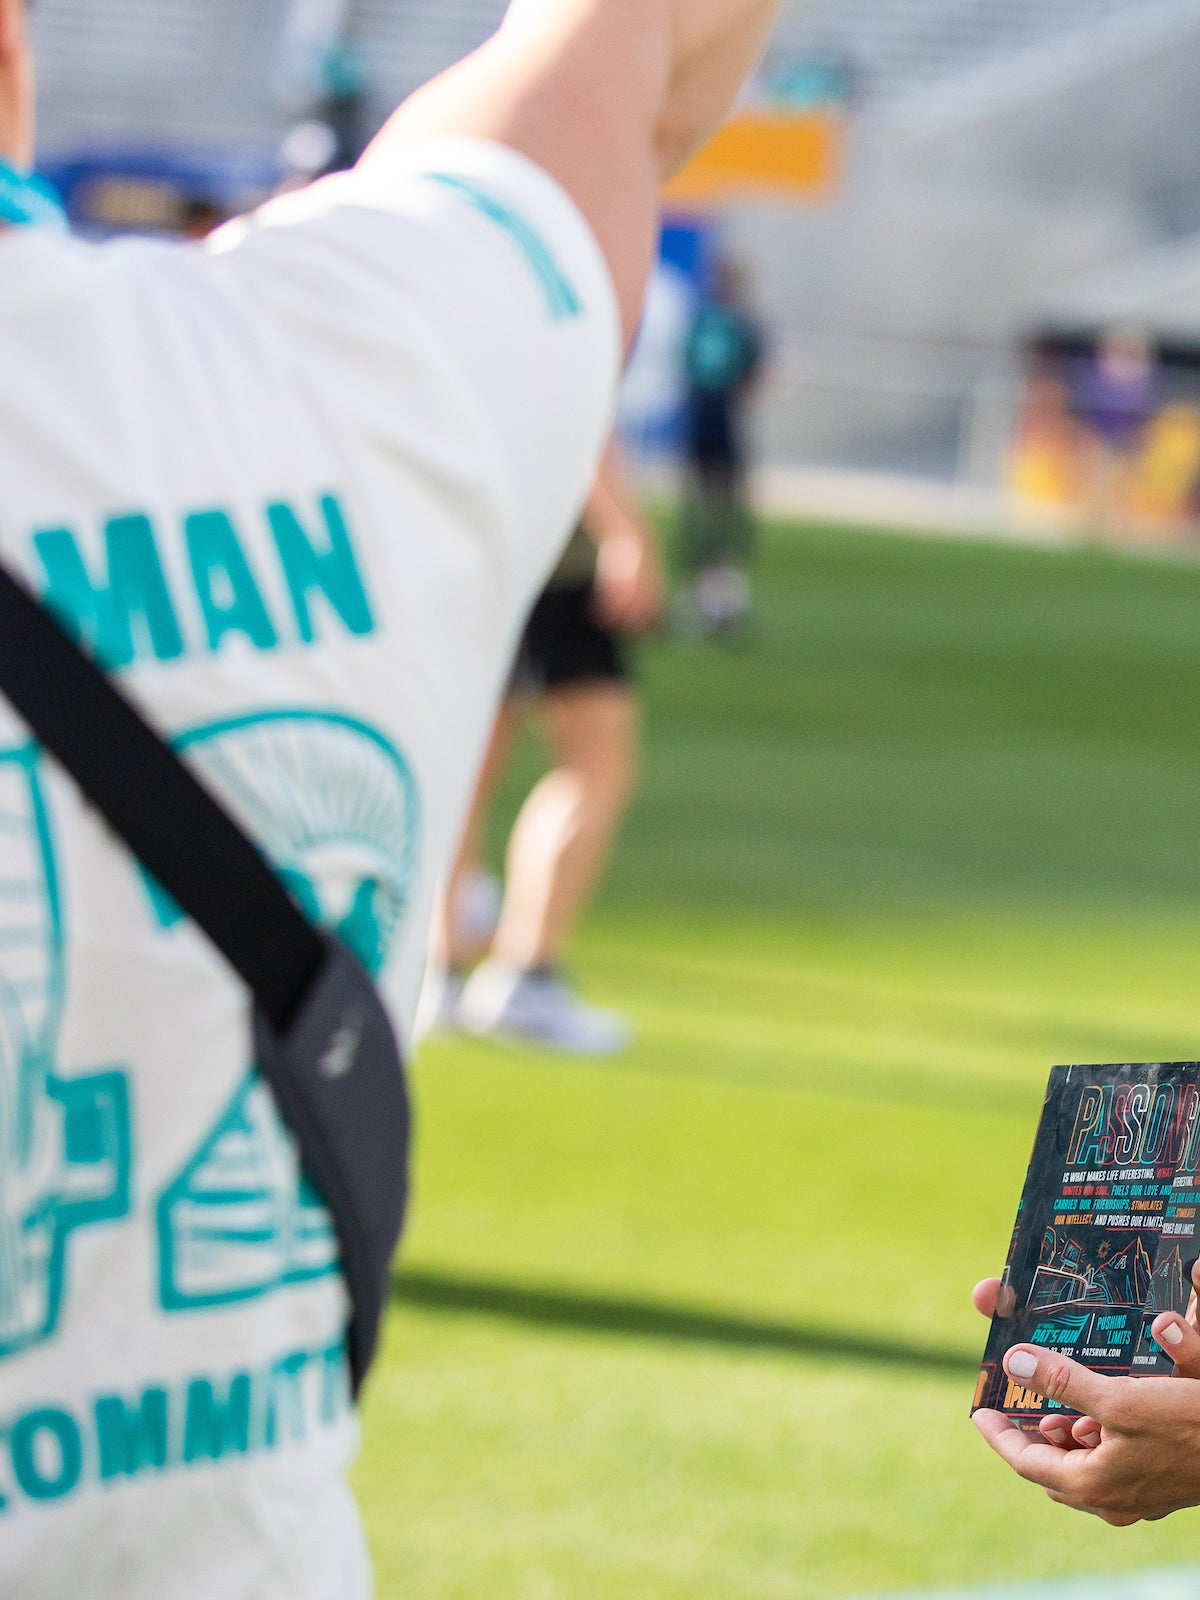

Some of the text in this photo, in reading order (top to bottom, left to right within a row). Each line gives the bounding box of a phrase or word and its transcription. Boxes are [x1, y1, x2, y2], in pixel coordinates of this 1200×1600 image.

[1065, 1083, 1196, 1166] PASSION
[1062, 1172, 1070, 1183] IS
[1070, 1171, 1087, 1182] WHAT
[1086, 1170, 1106, 1182] MAKES
[1106, 1169, 1120, 1181] LIFE
[1119, 1168, 1154, 1180] INTERESTING,
[1111, 1184, 1130, 1196] FUELS
[1130, 1184, 1143, 1196] OUR
[1143, 1184, 1158, 1196] LOVE
[1160, 1184, 1173, 1196] AND
[1053, 1198, 1079, 1210] CARRIES
[1079, 1198, 1092, 1210] OUR
[1130, 1200, 1164, 1211] STIMULATES
[1054, 1214, 1066, 1225] OUR
[1094, 1214, 1108, 1226] AND
[1107, 1214, 1130, 1227] PUSHES
[1130, 1215, 1143, 1227] OUR
[1143, 1216, 1164, 1228] LIMITS.
[1096, 1314, 1127, 1331] PUSHING
[1030, 1329, 1060, 1343] PAT'S
[1107, 1330, 1132, 1345] LIMITS
[1081, 1347, 1122, 1358] PATSRUN.COM
